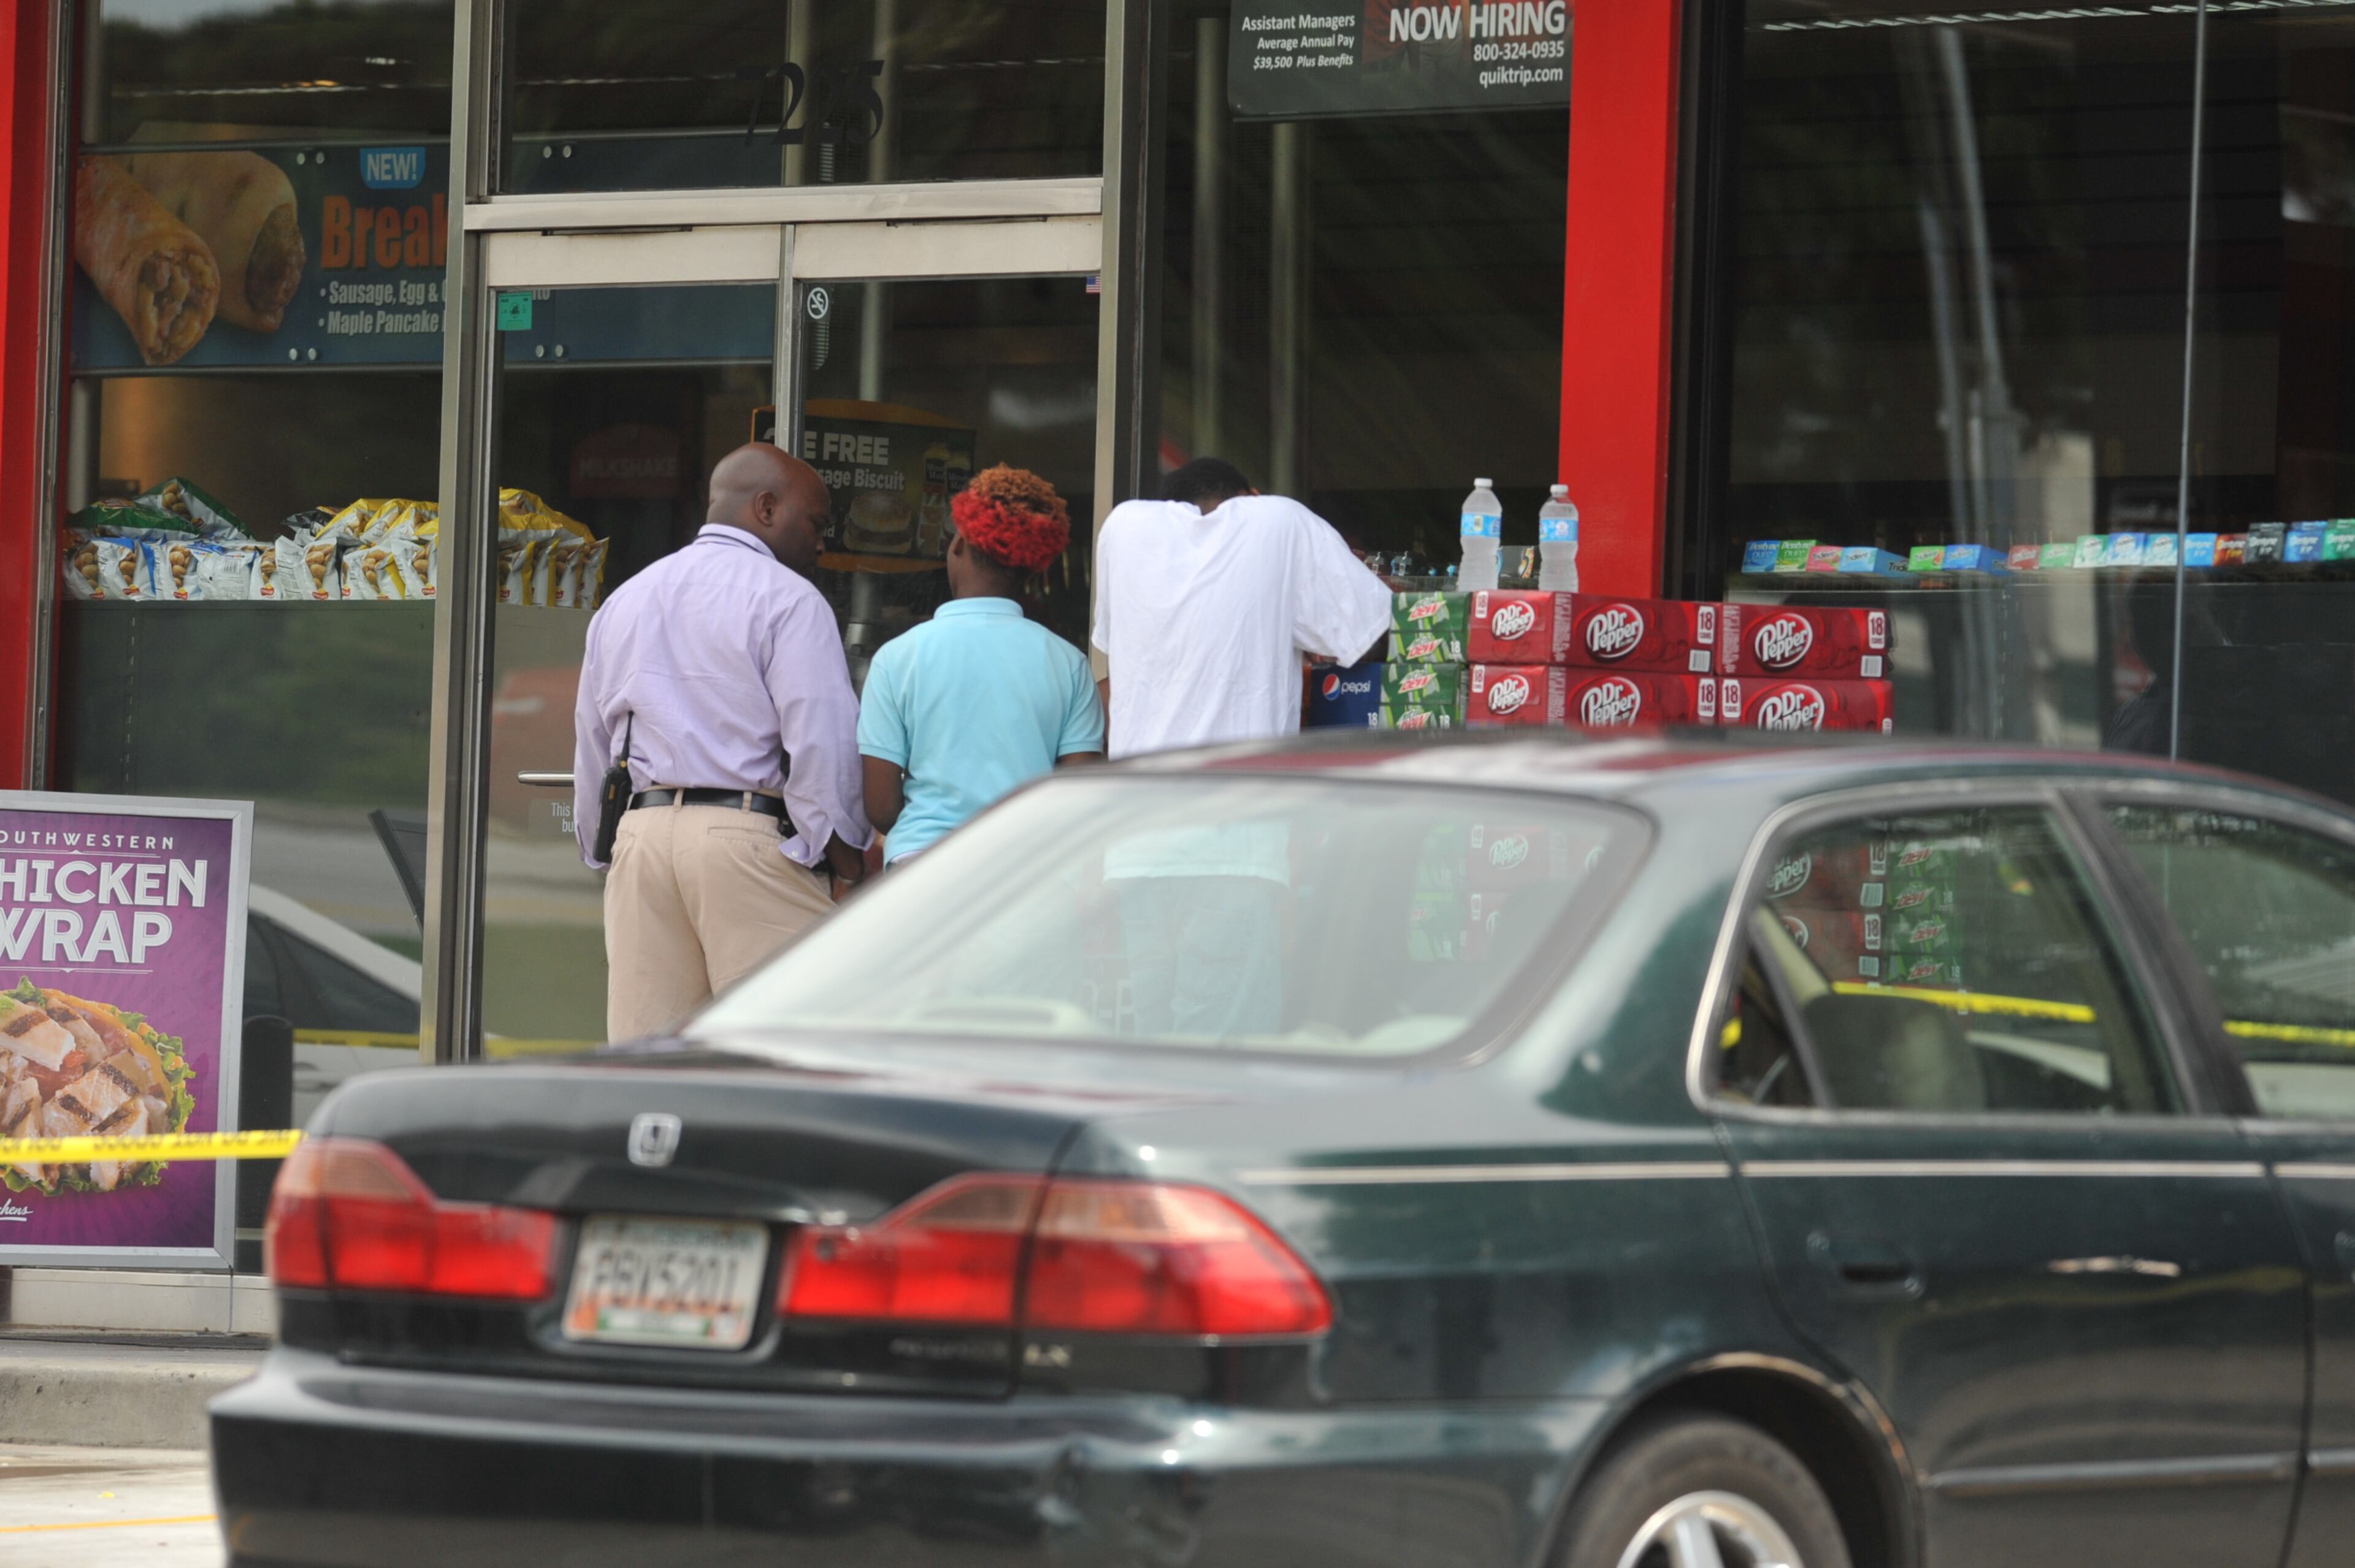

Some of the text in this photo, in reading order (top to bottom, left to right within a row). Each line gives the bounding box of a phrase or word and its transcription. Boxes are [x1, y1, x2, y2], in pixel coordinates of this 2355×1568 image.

[1241, 14, 1355, 31] Assistant Managers
[1389, 1, 1566, 42] NOW HIRING
[1257, 34, 1355, 52] Average Annual Pay
[1473, 40, 1565, 62] 800-324-0935
[1253, 53, 1354, 71] $39,500 Plus Benefits
[1479, 65, 1563, 89] quiktrip.com
[367, 153, 418, 181] NEW!
[329, 280, 438, 306] Sausage, Egg &
[327, 309, 440, 335] Maple Pancake
[822, 432, 890, 466] FREE
[854, 468, 905, 491] Biscuit
[1506, 605, 1523, 621] Dr
[1607, 609, 1628, 628] Dr
[1699, 611, 1713, 630] 18
[1592, 613, 1641, 652] Pepper
[1776, 619, 1797, 637] Dr
[1871, 617, 1883, 635] 18
[1761, 624, 1808, 662] Pepper
[1341, 680, 1371, 695] pepsi
[1504, 678, 1519, 695] Dr
[1601, 682, 1624, 706] Dr
[1701, 684, 1714, 703] 18
[1725, 685, 1739, 703] 18
[1588, 687, 1637, 727] Pepper
[1782, 691, 1805, 716] Dr
[1368, 712, 1379, 726] 18
[1439, 714, 1450, 729] 18
[551, 802, 570, 817] This
[0, 858, 208, 908] HICKEN
[0, 908, 172, 963] WRAP
[1867, 918, 1879, 938] 18
